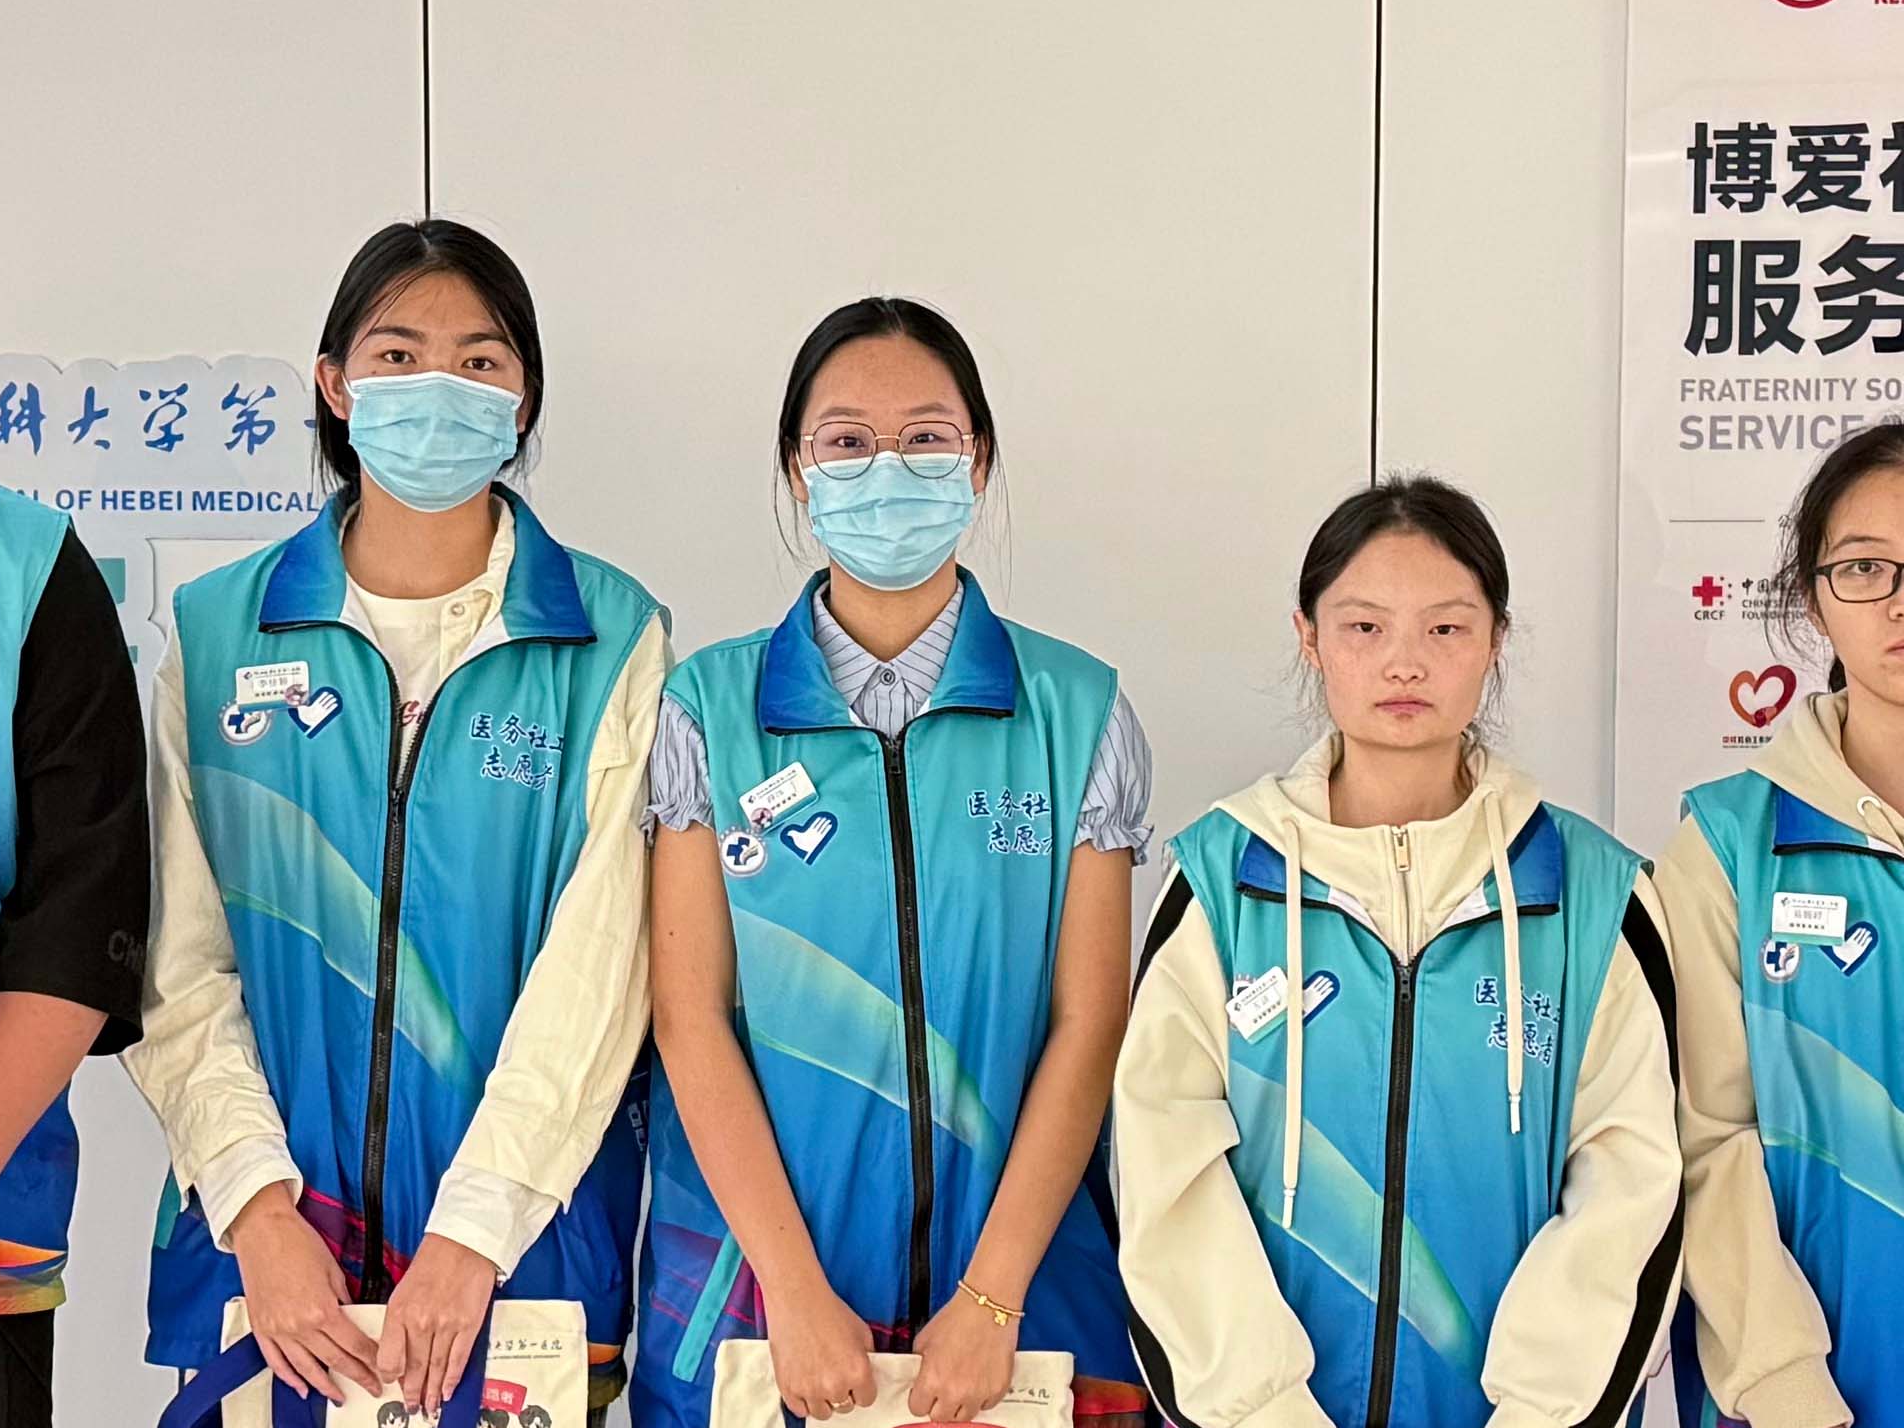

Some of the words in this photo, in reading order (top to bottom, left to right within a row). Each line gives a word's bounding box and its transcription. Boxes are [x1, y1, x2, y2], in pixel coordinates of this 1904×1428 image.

[1680, 379, 1858, 402] FRATERNITY
[56, 489, 92, 511] OF
[101, 490, 183, 511] HEBEI
[192, 490, 321, 513] MEDICAL
[1694, 610, 1726, 621] CRCF
